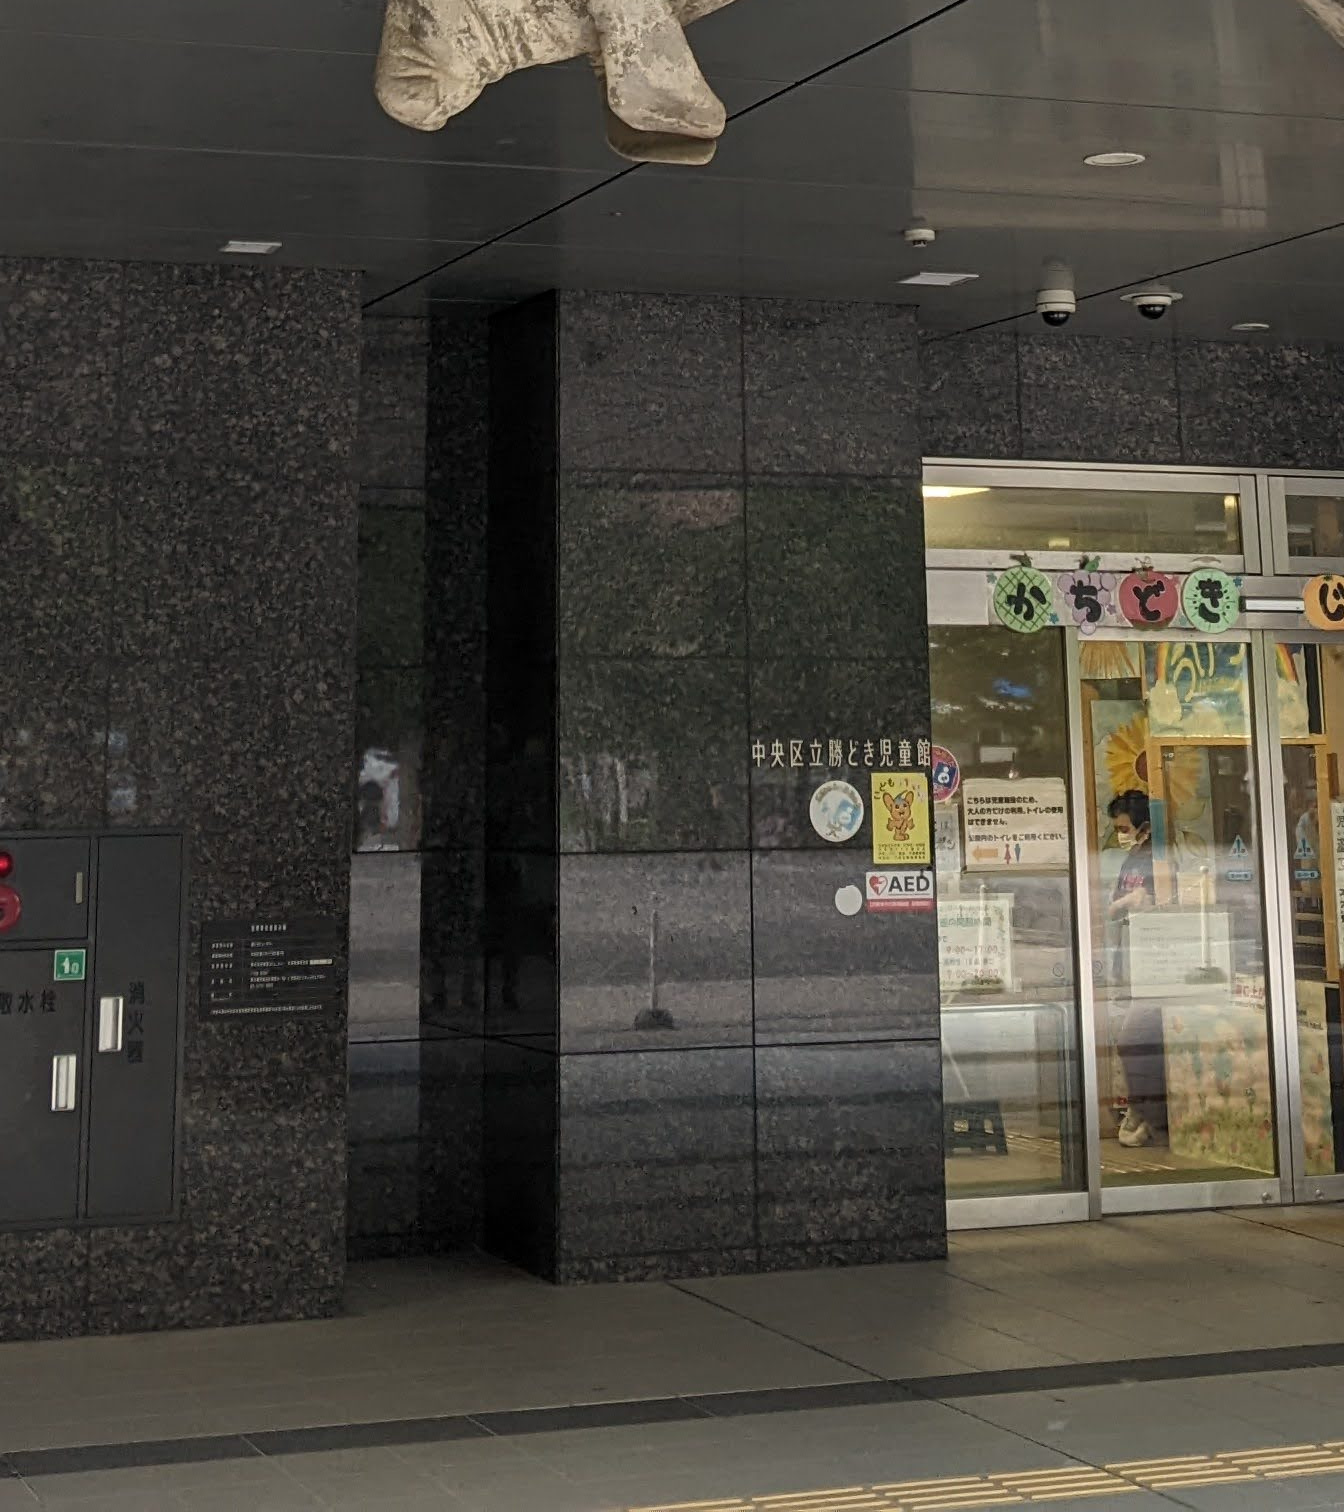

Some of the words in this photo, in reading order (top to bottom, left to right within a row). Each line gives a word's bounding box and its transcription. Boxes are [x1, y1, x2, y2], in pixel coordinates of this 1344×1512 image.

[1007, 576, 1225, 623] かちどき
[752, 738, 931, 768] 中央区立勝どき児童館
[888, 876, 930, 893] AED
